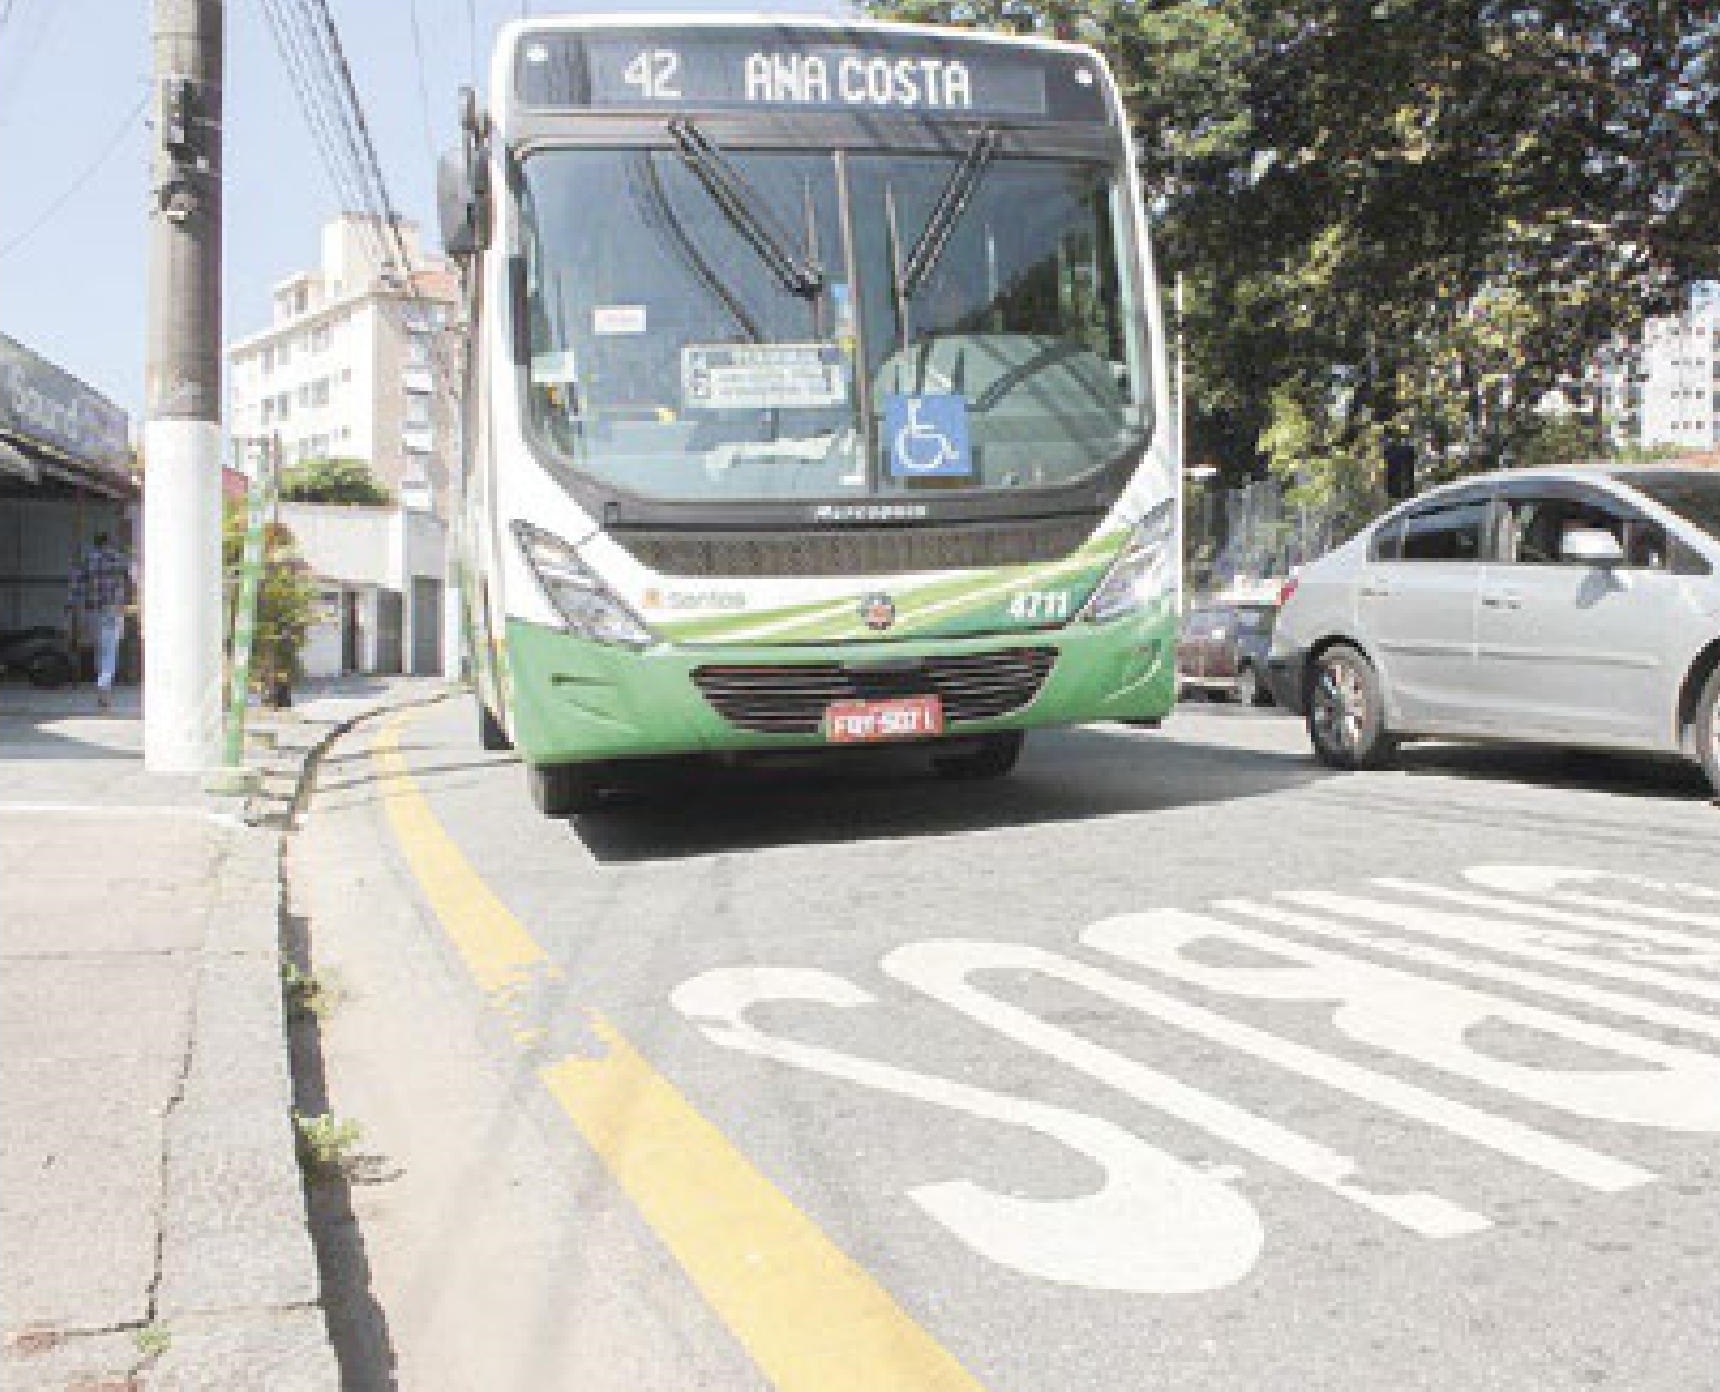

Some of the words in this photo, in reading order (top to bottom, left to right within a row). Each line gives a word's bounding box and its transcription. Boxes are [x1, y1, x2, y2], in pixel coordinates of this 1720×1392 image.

[623, 49, 683, 99] 42
[744, 52, 828, 102] ANA
[838, 57, 971, 109] COSTA
[1007, 590, 1069, 621] 4711
